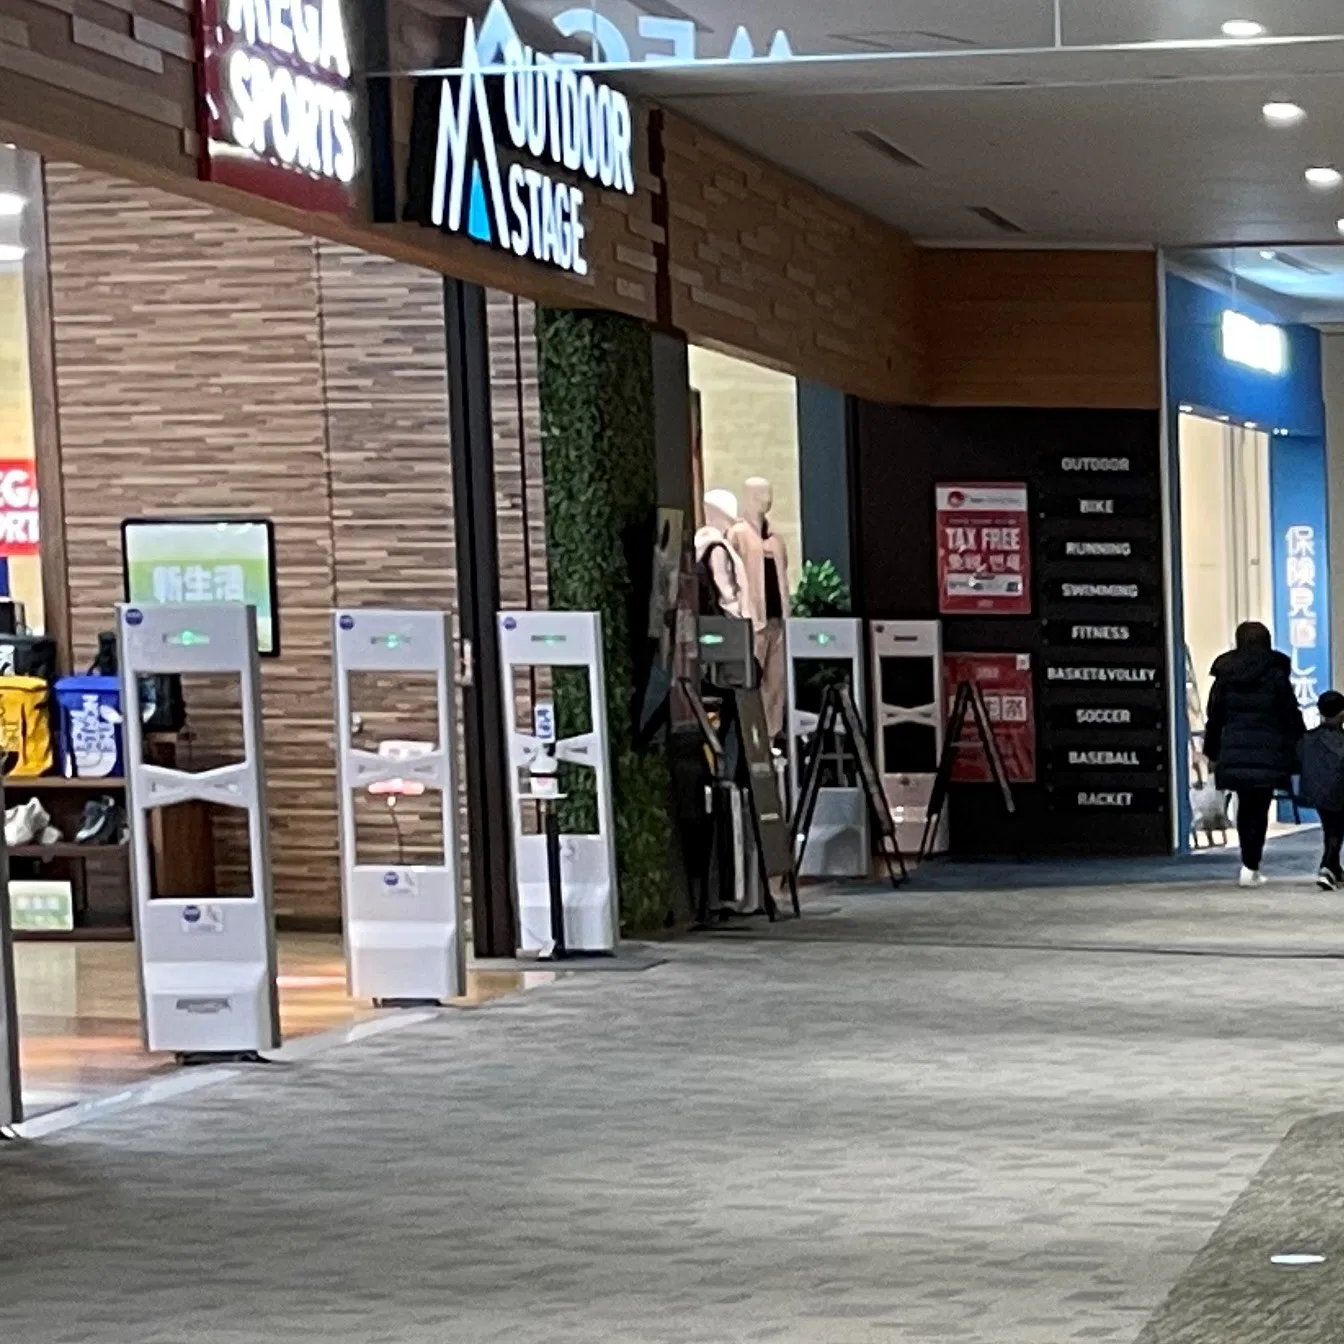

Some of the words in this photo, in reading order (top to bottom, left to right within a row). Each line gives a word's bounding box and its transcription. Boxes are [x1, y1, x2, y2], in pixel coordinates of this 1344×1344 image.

[230, 50, 355, 182] SPORTS
[504, 40, 635, 195] OUTDOOR
[508, 163, 588, 276] STAGE
[1061, 457, 1130, 471] OUTDOOR
[1080, 500, 1114, 513] BIKE
[945, 528, 977, 550] TAX
[981, 528, 1020, 550] FREE
[1065, 542, 1131, 556] RUNNING
[1061, 583, 1138, 598] SWIMMING
[1071, 625, 1129, 640] FITNESS
[1047, 667, 1156, 681] BASKET&VOLLEY
[1076, 709, 1131, 723] SOCCER
[1068, 751, 1140, 765] BASEBALL
[1077, 792, 1133, 806] RACKET
